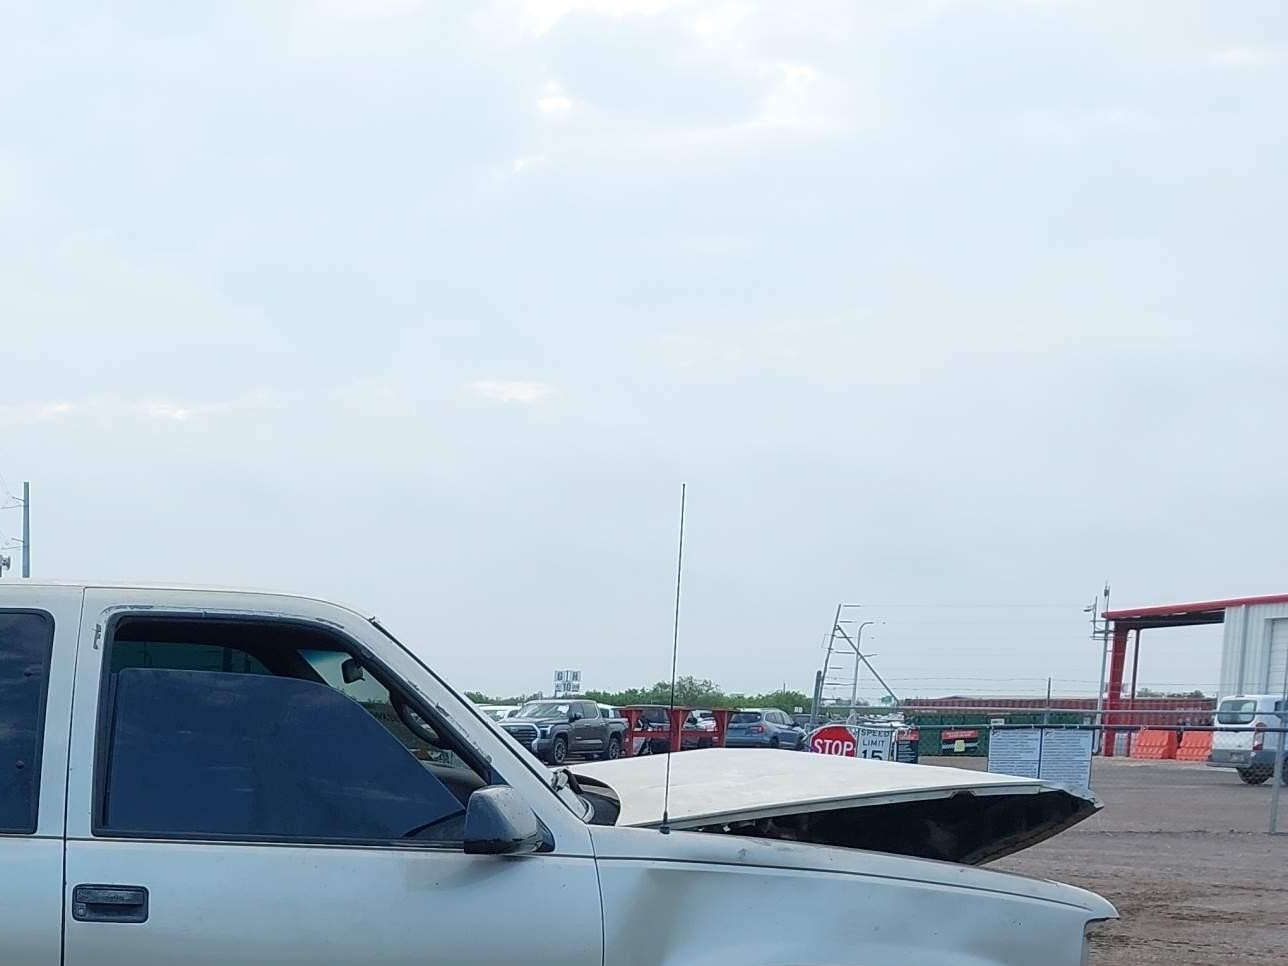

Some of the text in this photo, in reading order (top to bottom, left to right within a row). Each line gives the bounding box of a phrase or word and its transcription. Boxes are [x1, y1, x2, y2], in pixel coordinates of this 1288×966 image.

[861, 729, 890, 738] SPEED
[813, 738, 854, 757] STOP
[862, 740, 885, 748] LIMIT
[862, 749, 884, 761] 15
